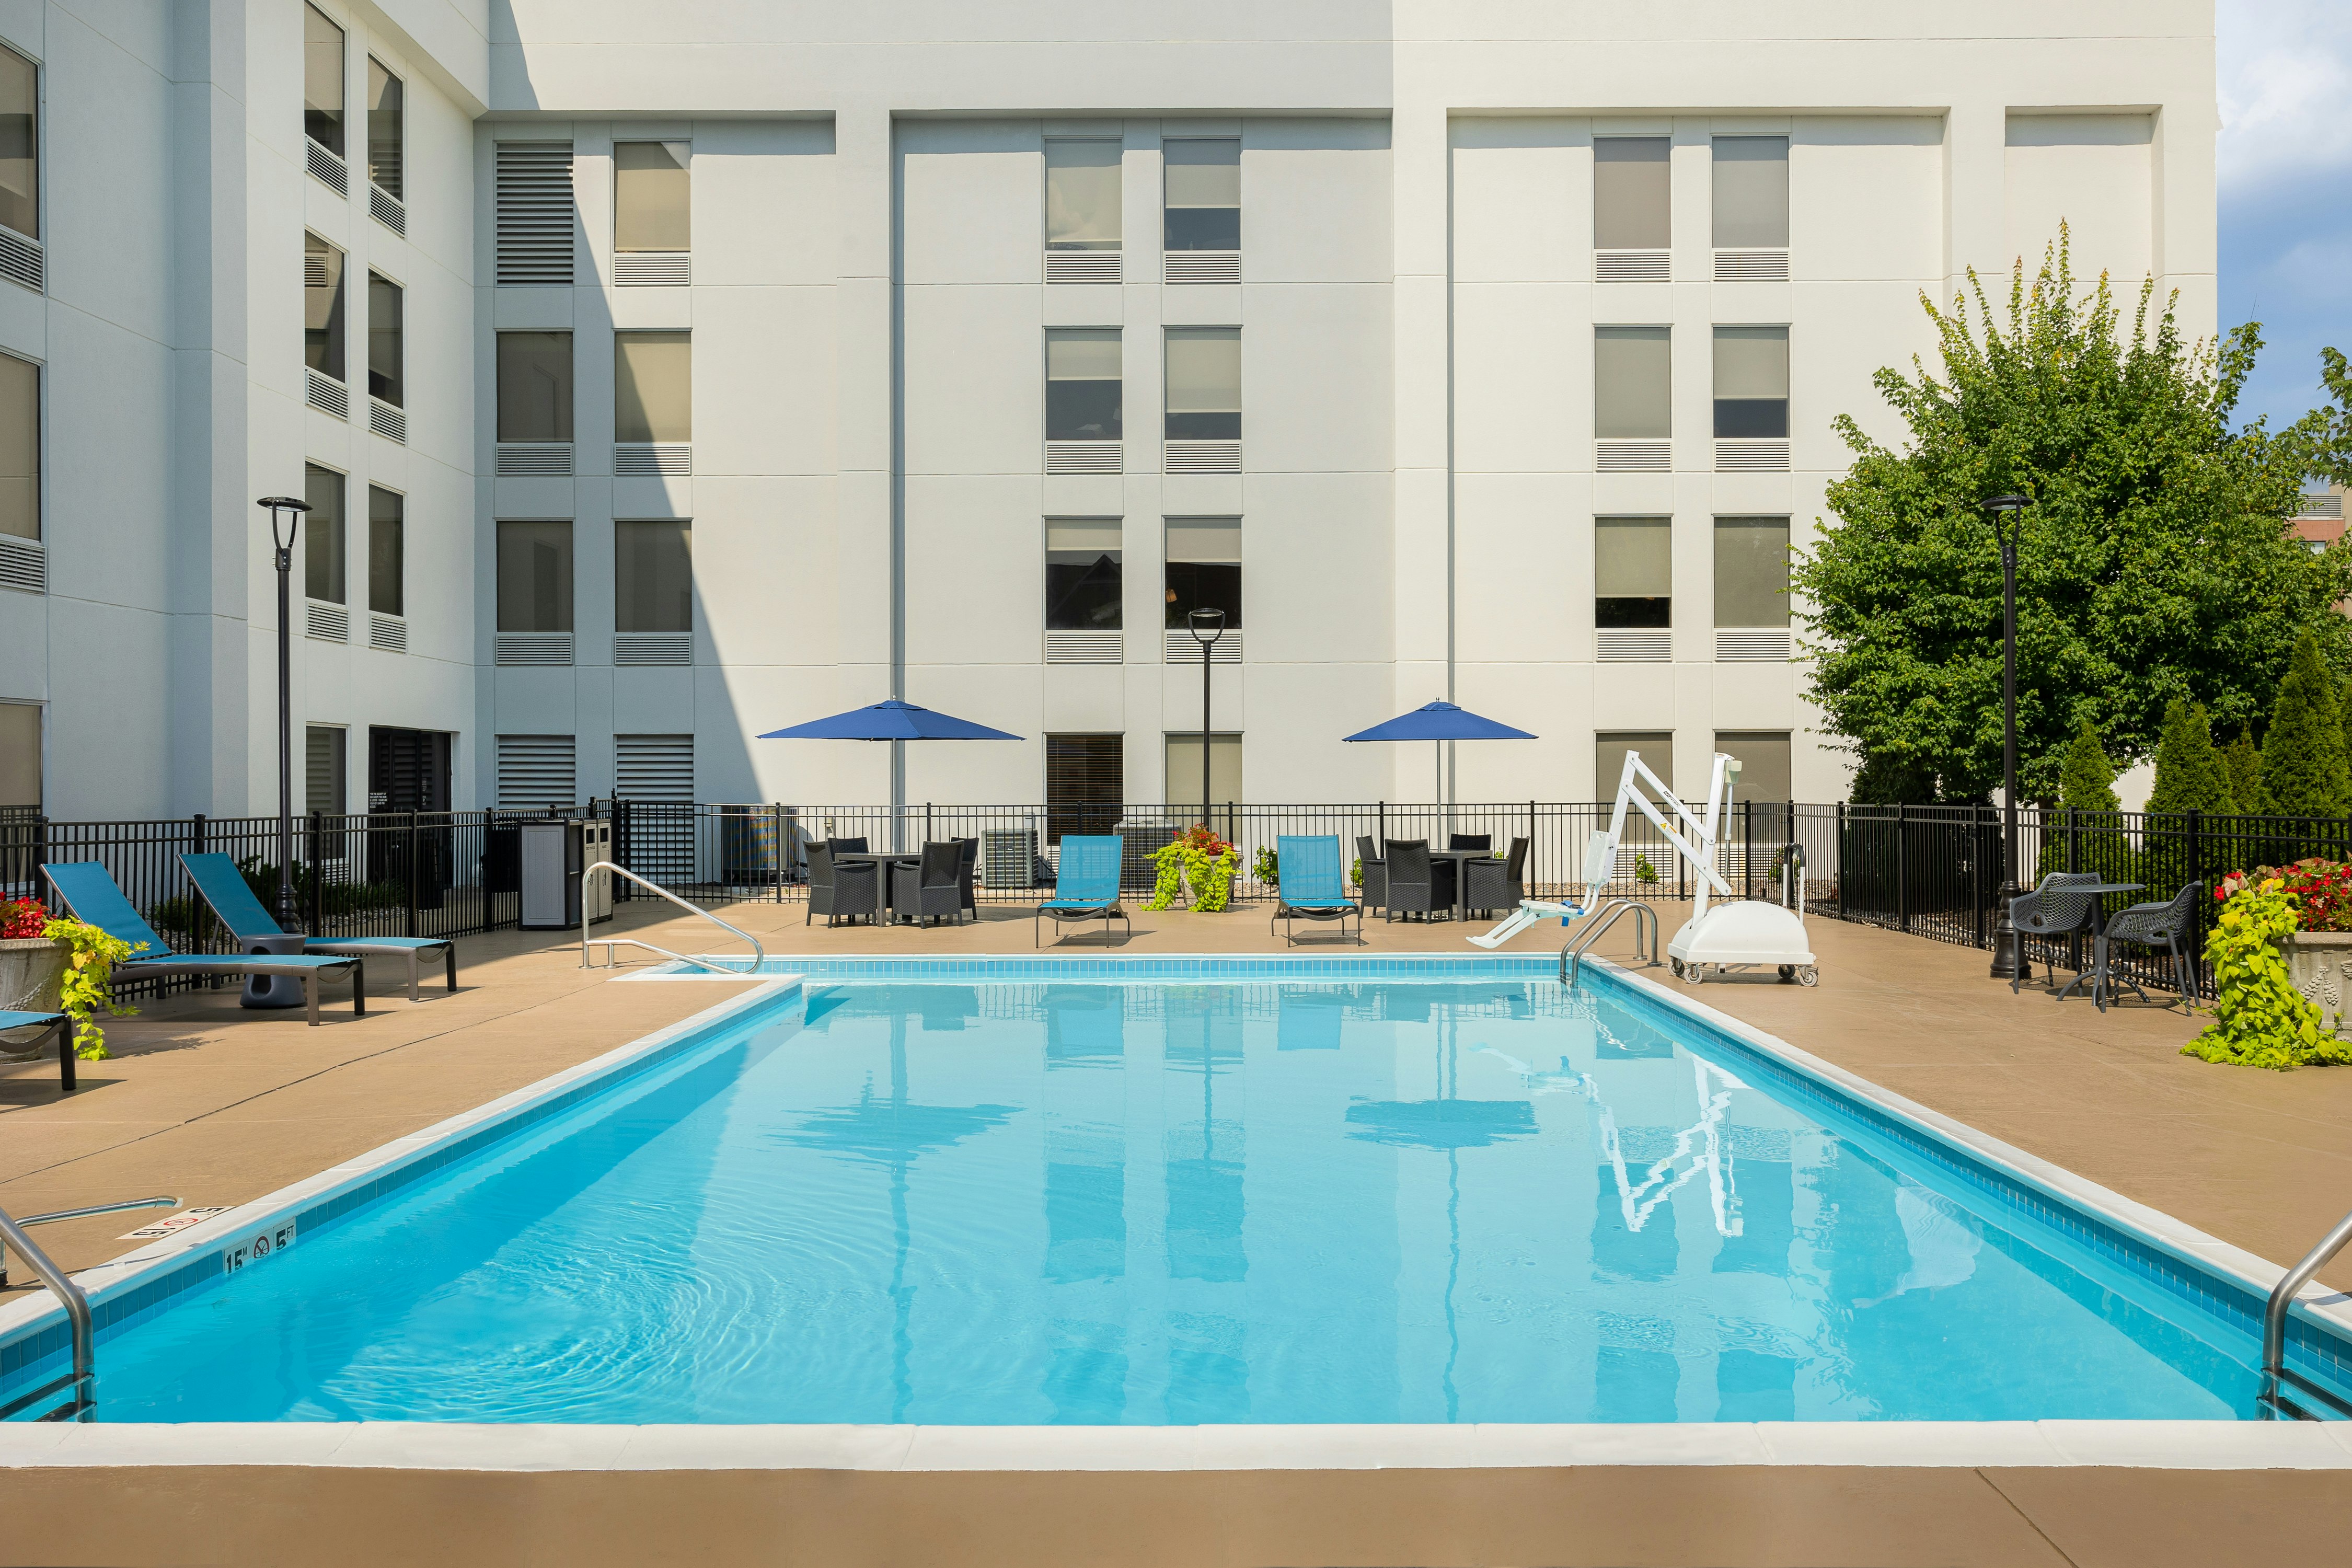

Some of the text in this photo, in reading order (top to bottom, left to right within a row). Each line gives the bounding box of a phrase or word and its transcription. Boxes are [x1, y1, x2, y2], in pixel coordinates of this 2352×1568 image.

[276, 1225, 294, 1250] 5 FT
[243, 1246, 247, 1256] M
